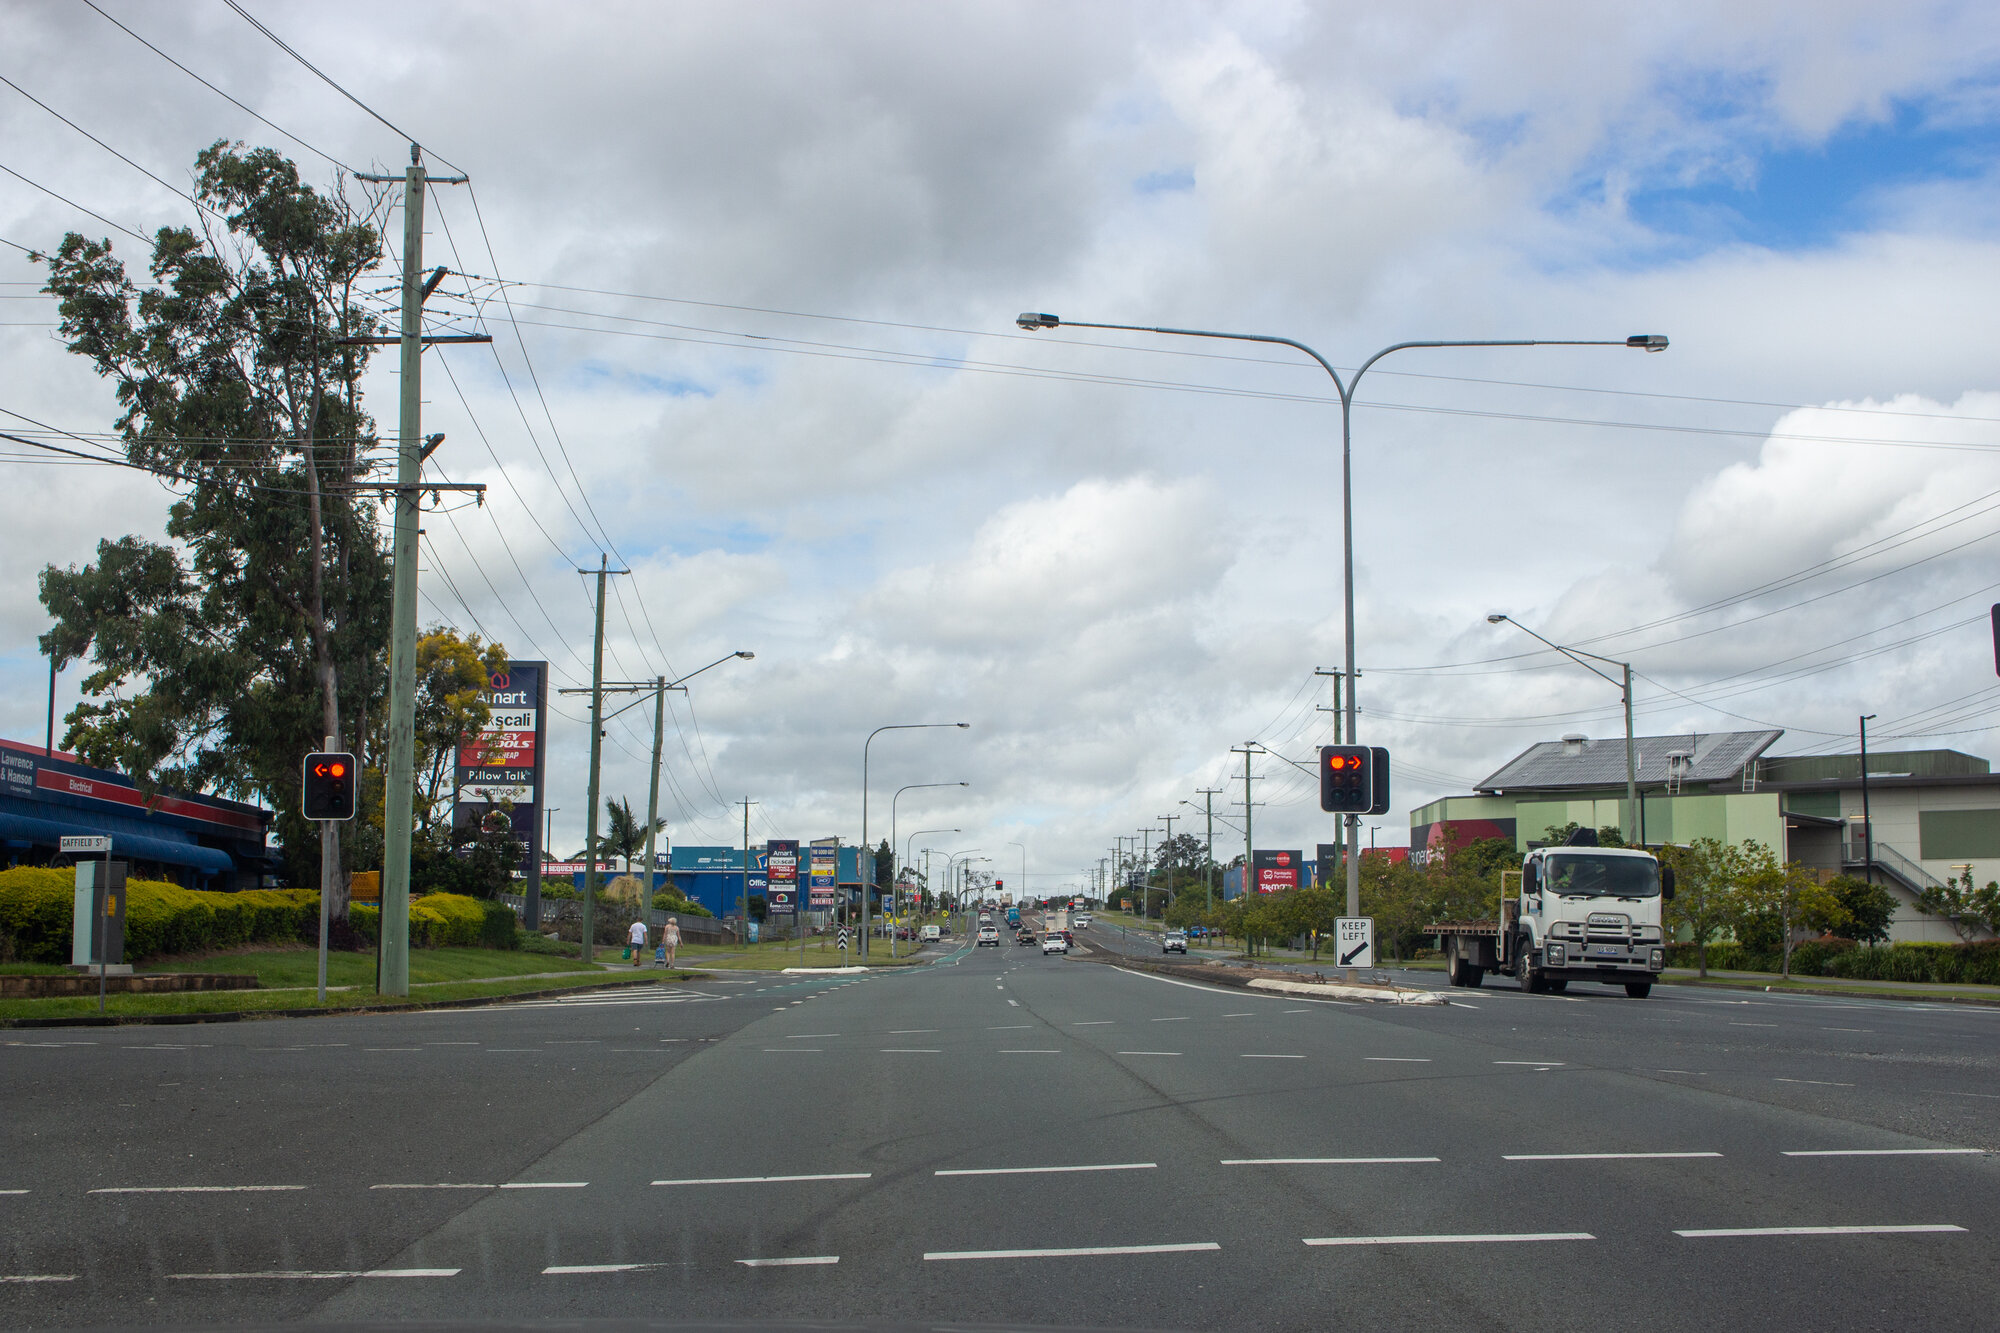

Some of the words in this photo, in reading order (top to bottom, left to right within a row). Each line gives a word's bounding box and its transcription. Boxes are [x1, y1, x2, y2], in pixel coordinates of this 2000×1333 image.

[1, 752, 33, 769] Lawrence
[0, 767, 6, 780] &
[7, 768, 32, 785] Hanson
[468, 770, 502, 780] Pillow
[504, 771, 526, 781] Talk
[69, 779, 93, 793] Electrical
[62, 838, 93, 847] GAFFIELD
[1341, 922, 1366, 930] KEEP
[1342, 932, 1366, 941] LEFT
